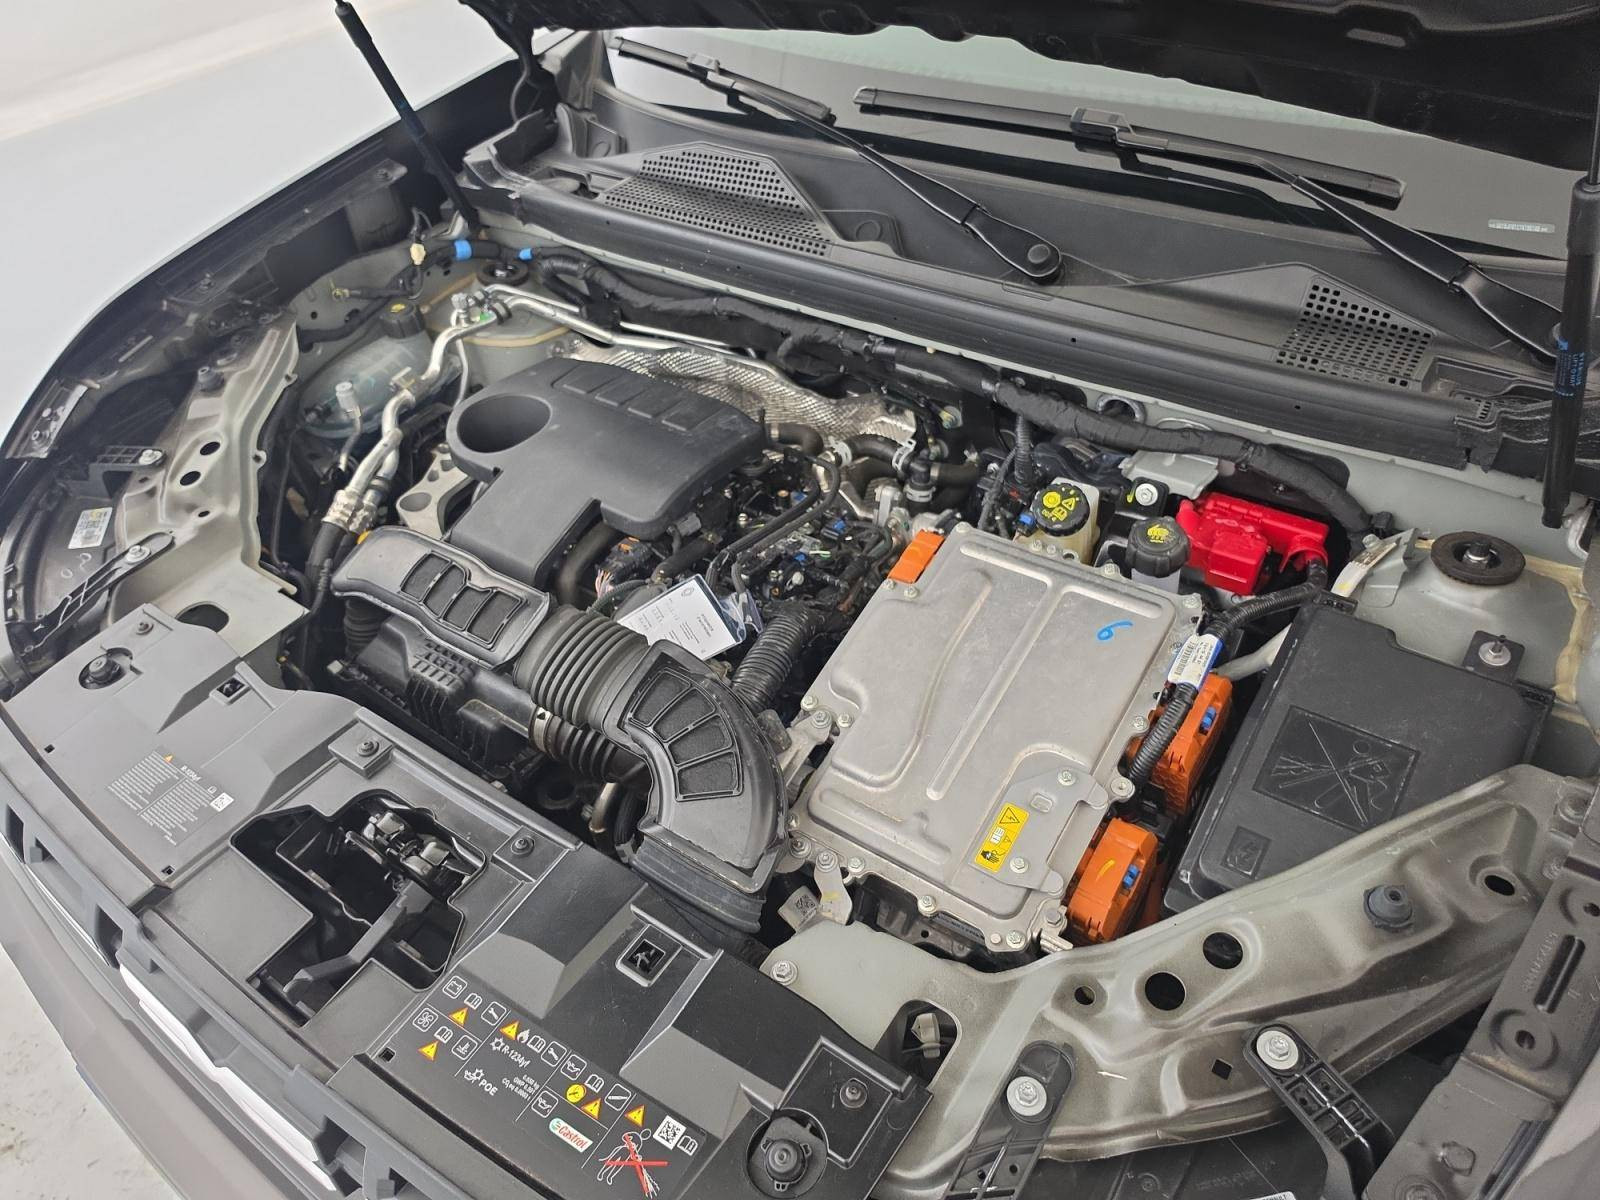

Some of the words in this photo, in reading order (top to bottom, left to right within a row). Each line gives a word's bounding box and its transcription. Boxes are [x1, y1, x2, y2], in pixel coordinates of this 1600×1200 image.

[501, 1045, 531, 1068] R-1234yf
[478, 1078, 498, 1096] POE
[558, 1125, 588, 1149] Castrol
